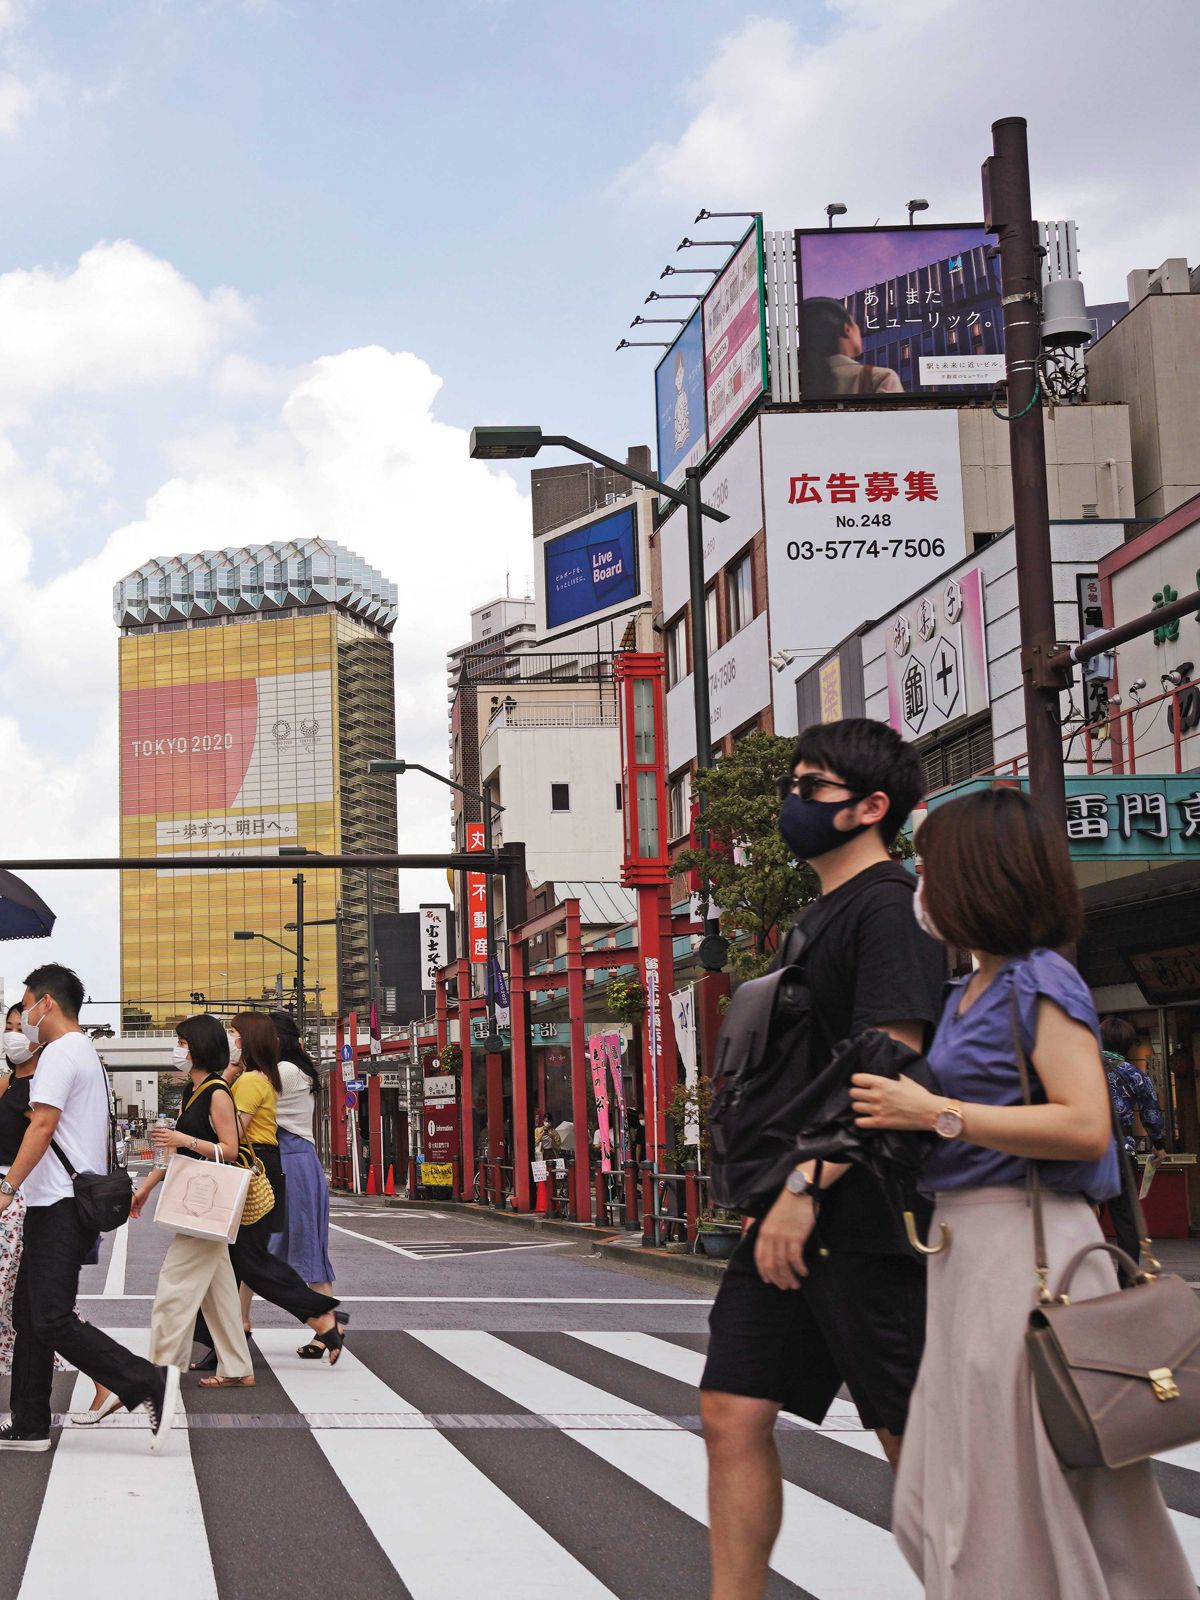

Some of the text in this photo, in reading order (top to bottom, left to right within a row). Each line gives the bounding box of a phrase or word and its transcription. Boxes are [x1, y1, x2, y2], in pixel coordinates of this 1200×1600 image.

[866, 311, 992, 330] ヒューリック。
[788, 471, 939, 504] 広告募集
[836, 514, 892, 528] No.248
[592, 551, 613, 568] Live
[787, 538, 945, 560] 03-5774-7506
[593, 559, 622, 583] Board
[132, 733, 233, 757] TOKYO 2020
[166, 819, 290, 840] 一歩ずつ、明日へ。
[471, 831, 488, 956] 丸不動産
